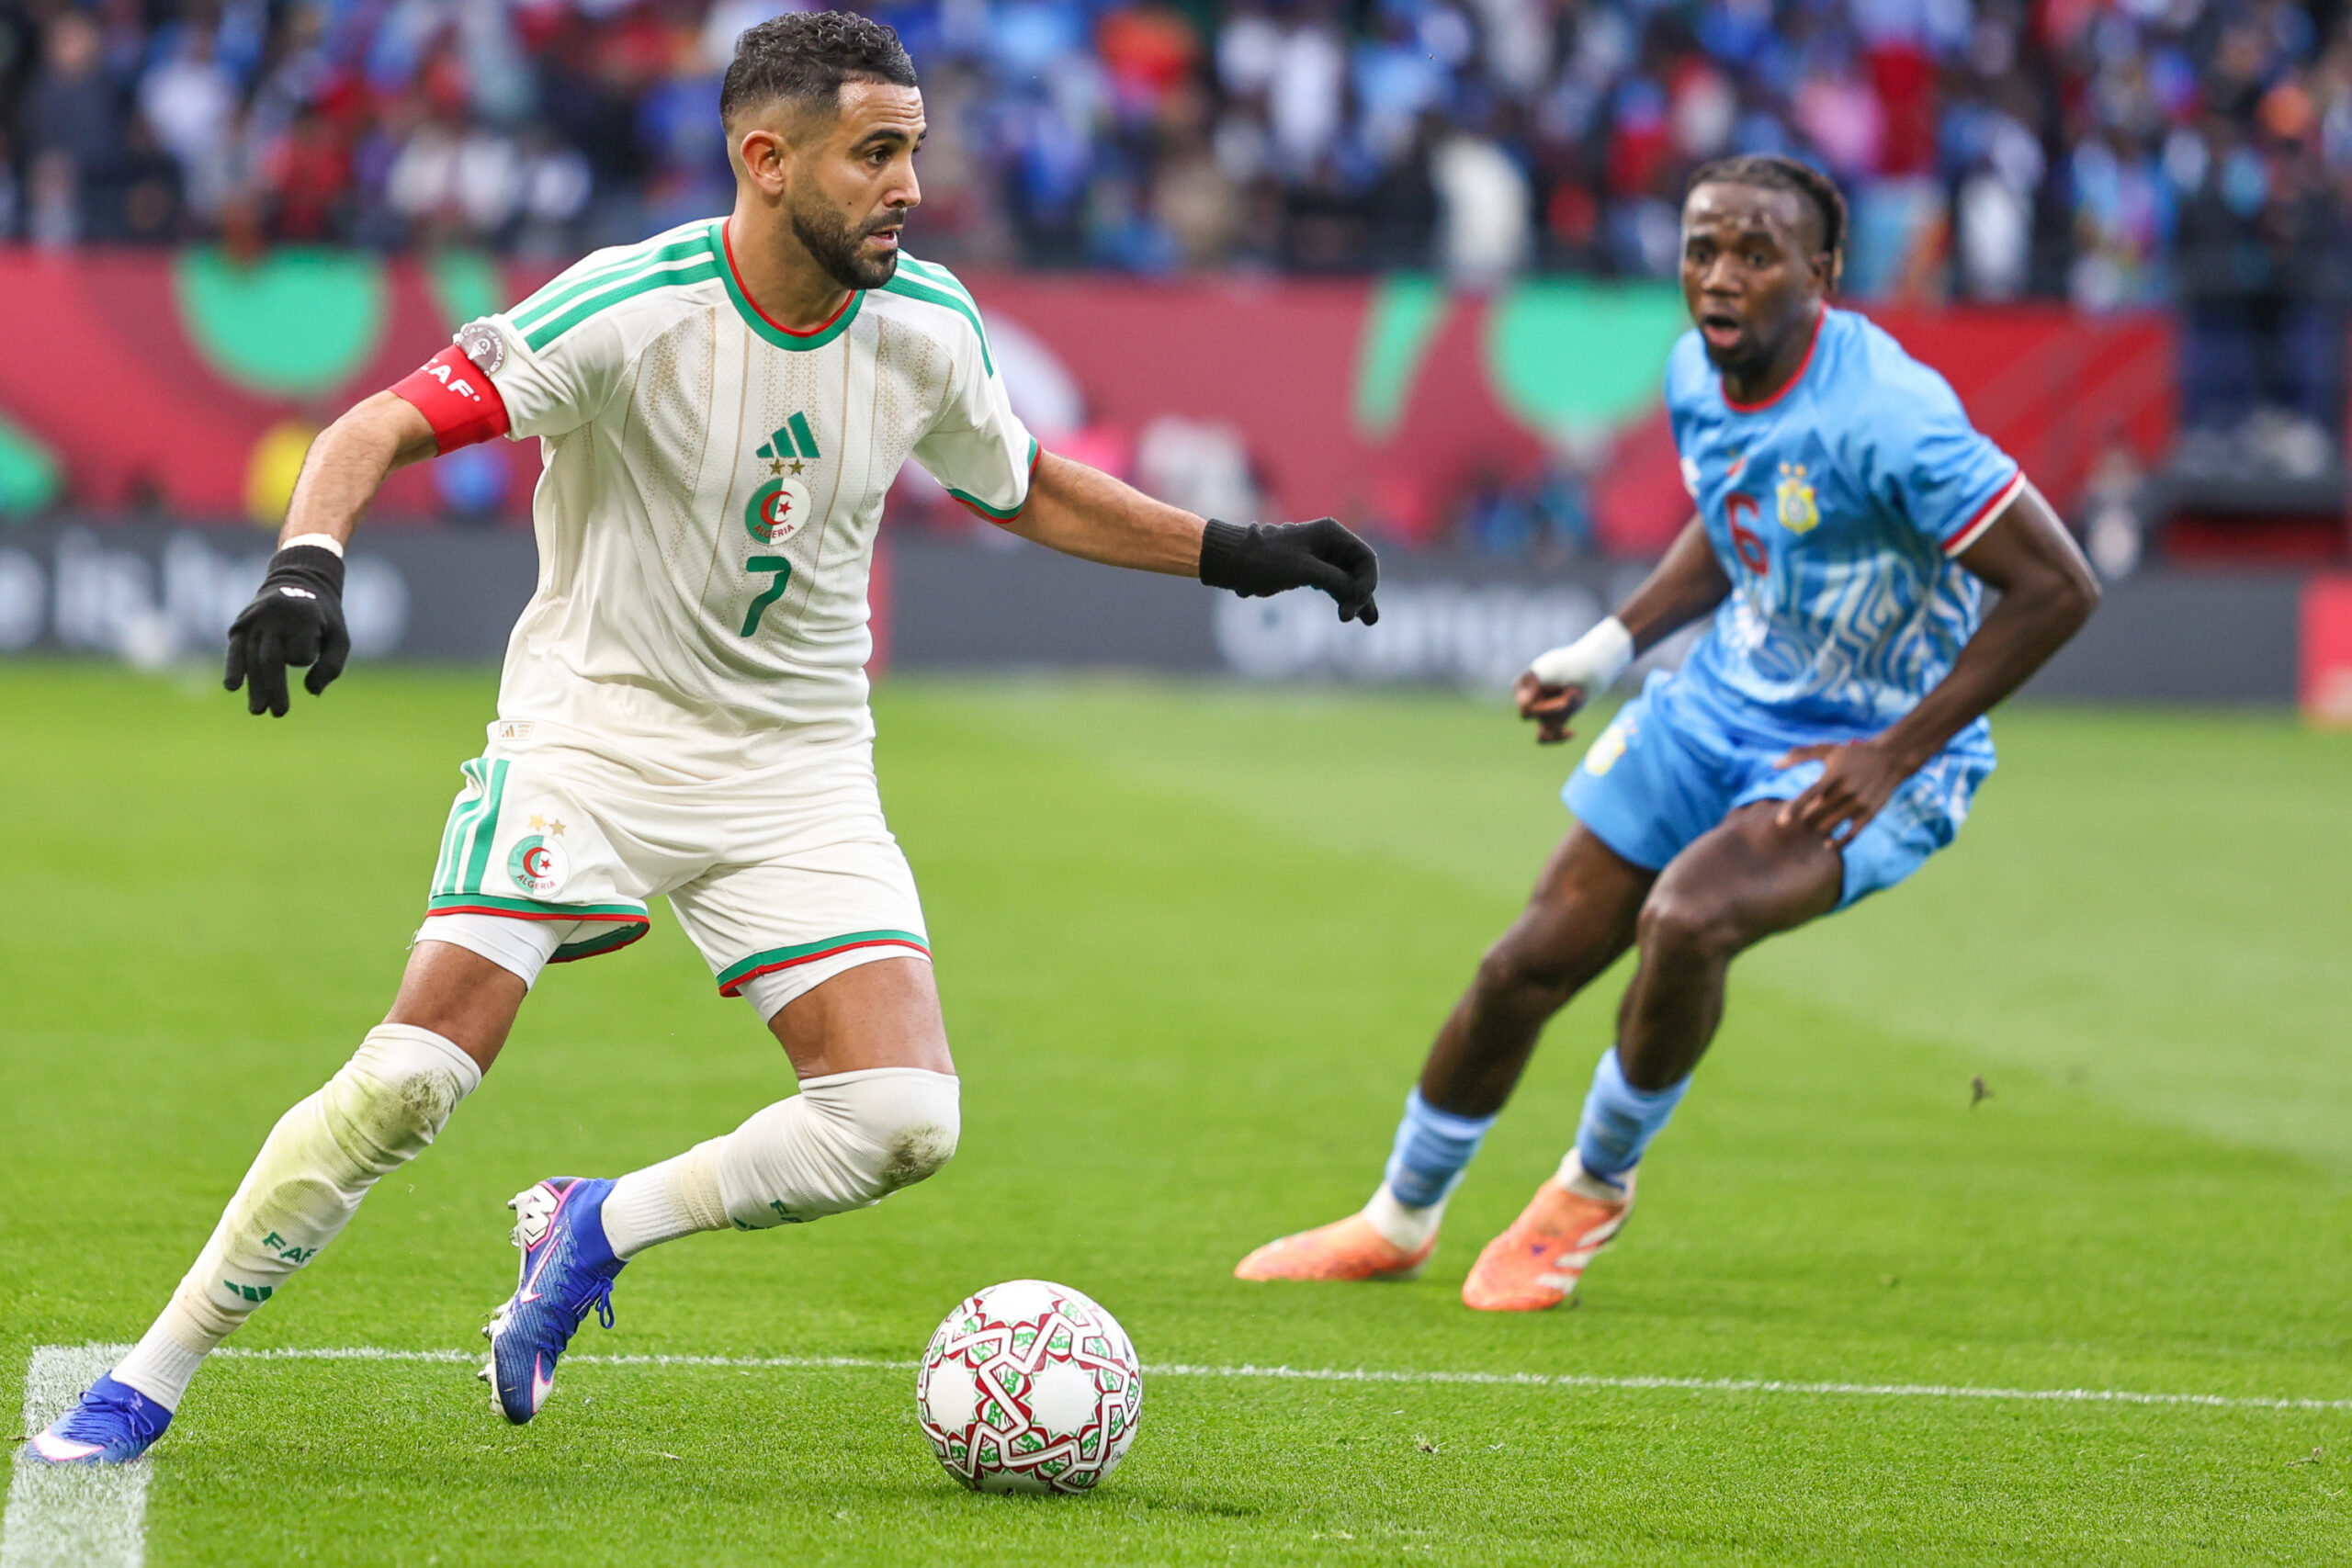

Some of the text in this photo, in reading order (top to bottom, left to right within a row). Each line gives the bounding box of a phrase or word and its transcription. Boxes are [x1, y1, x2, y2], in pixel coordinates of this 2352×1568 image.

[752, 524, 795, 539] ALGERIA
[1724, 491, 1770, 578] 6
[740, 556, 792, 638] 7
[516, 874, 557, 890] ALGERIA
